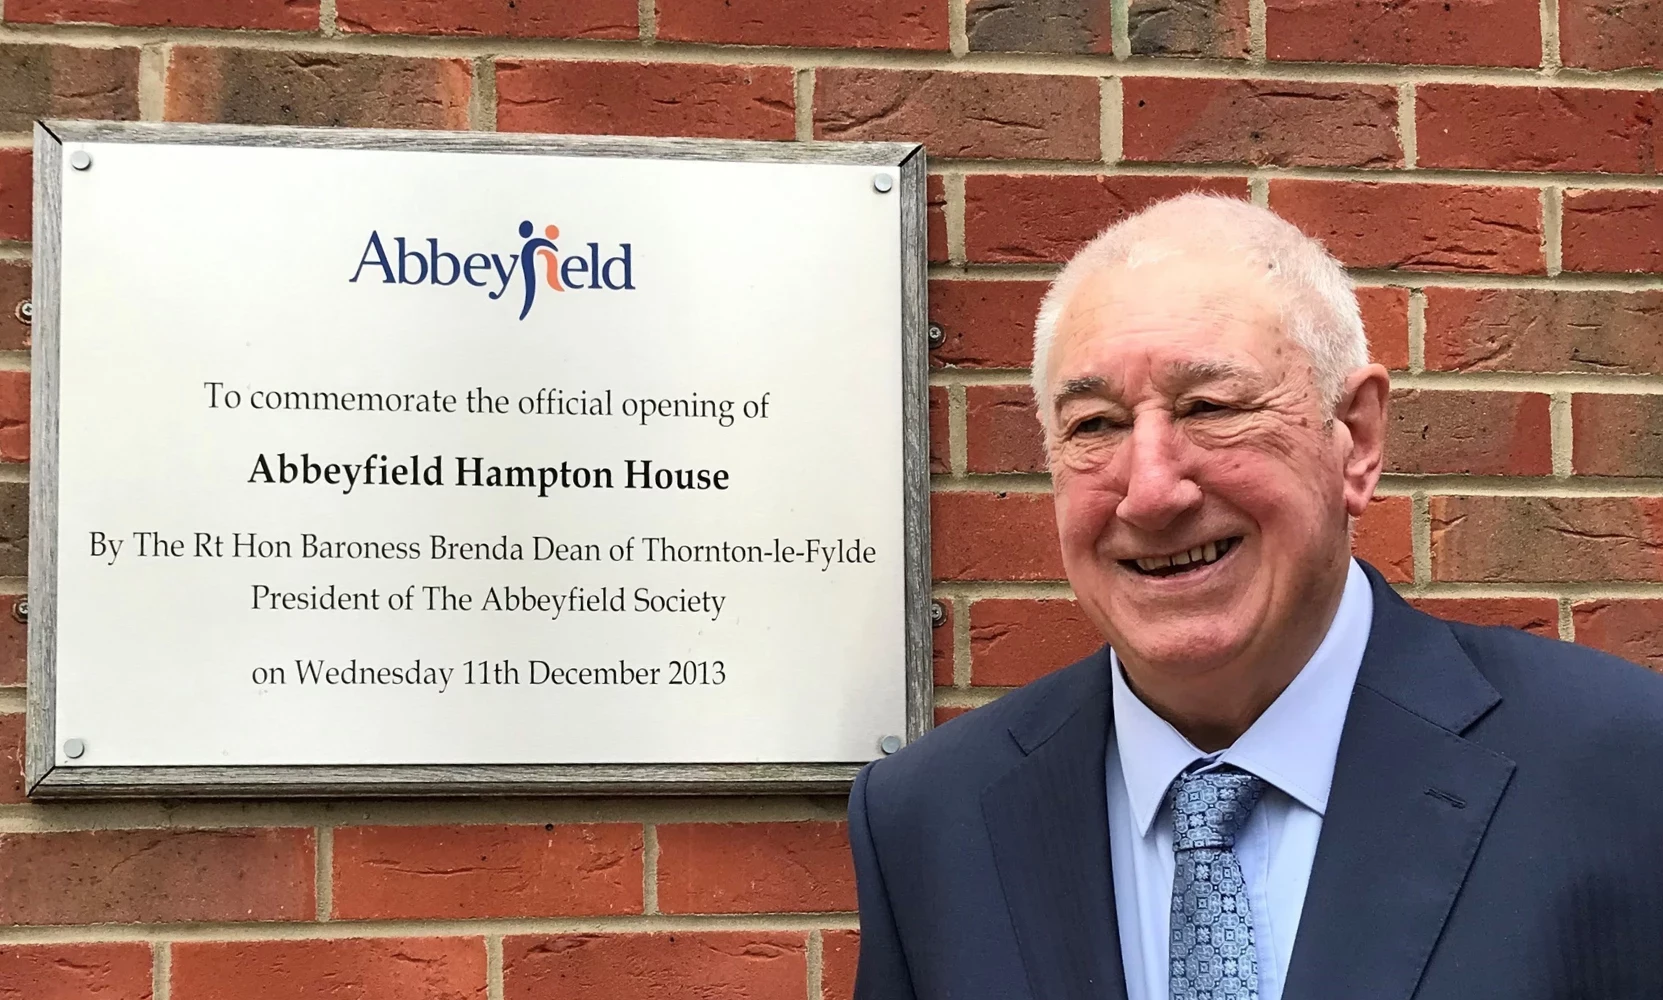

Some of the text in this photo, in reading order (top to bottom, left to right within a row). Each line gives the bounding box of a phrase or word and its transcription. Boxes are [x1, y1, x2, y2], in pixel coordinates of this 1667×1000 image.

[348, 220, 636, 321] Abbeyfield
[203, 382, 770, 428] To commemorate the official opening of
[247, 452, 729, 498] Abbeyfield Hampton House
[90, 531, 876, 572] By The Rt Hon Baroness Brenda Dean of Thornton-le-Fylde
[253, 584, 726, 622] President of The Abbeyfield Society
[252, 659, 726, 694] on Wednesday 11th December 2013
